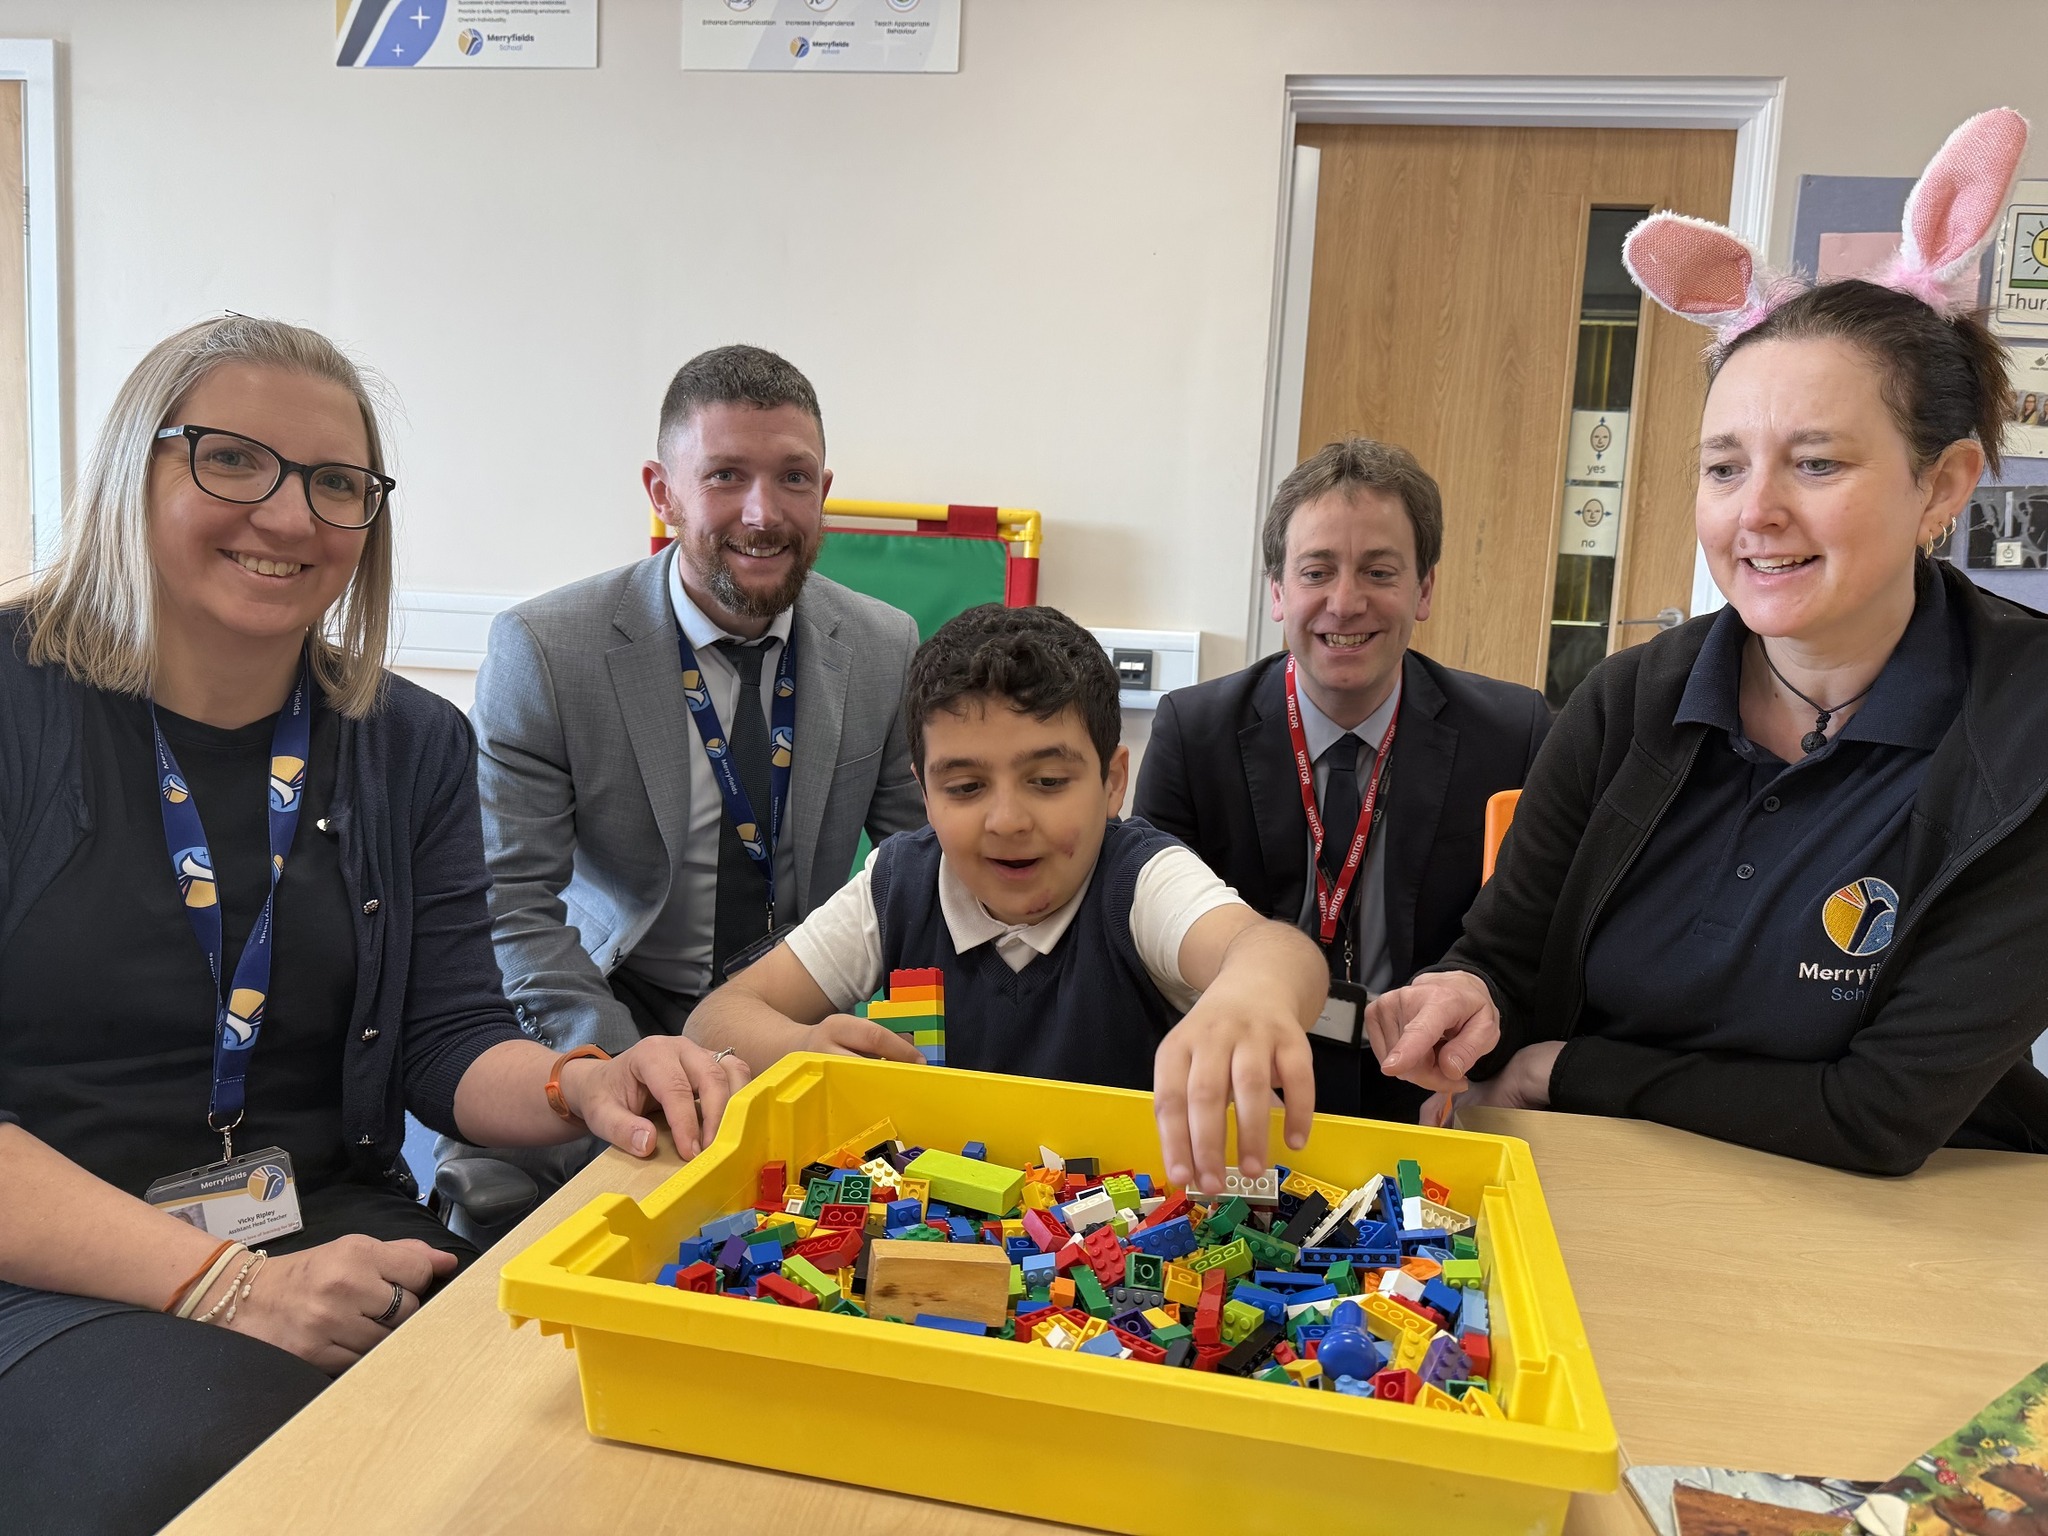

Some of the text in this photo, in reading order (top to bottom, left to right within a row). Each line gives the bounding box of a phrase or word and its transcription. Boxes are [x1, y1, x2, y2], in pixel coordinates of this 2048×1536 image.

[487, 34, 535, 43] Merryfields
[812, 41, 849, 49] Merryfields
[1586, 464, 1606, 476] yes
[1581, 539, 1596, 548] no
[1287, 694, 1299, 729] VISITOR
[1379, 724, 1397, 757] VISITOR
[721, 759, 738, 795] Merryfields
[1297, 750, 1311, 785] VISITOR
[1364, 778, 1378, 812] VISITOR
[1347, 834, 1365, 868] VISITOR
[1328, 887, 1346, 920] VISITOR
[1831, 987, 1865, 1001] Sch
[200, 1171, 247, 1190] Merryfields
[228, 1214, 287, 1235] Assistant Head Teacher
[237, 1210, 275, 1225] Vicky Ripley
